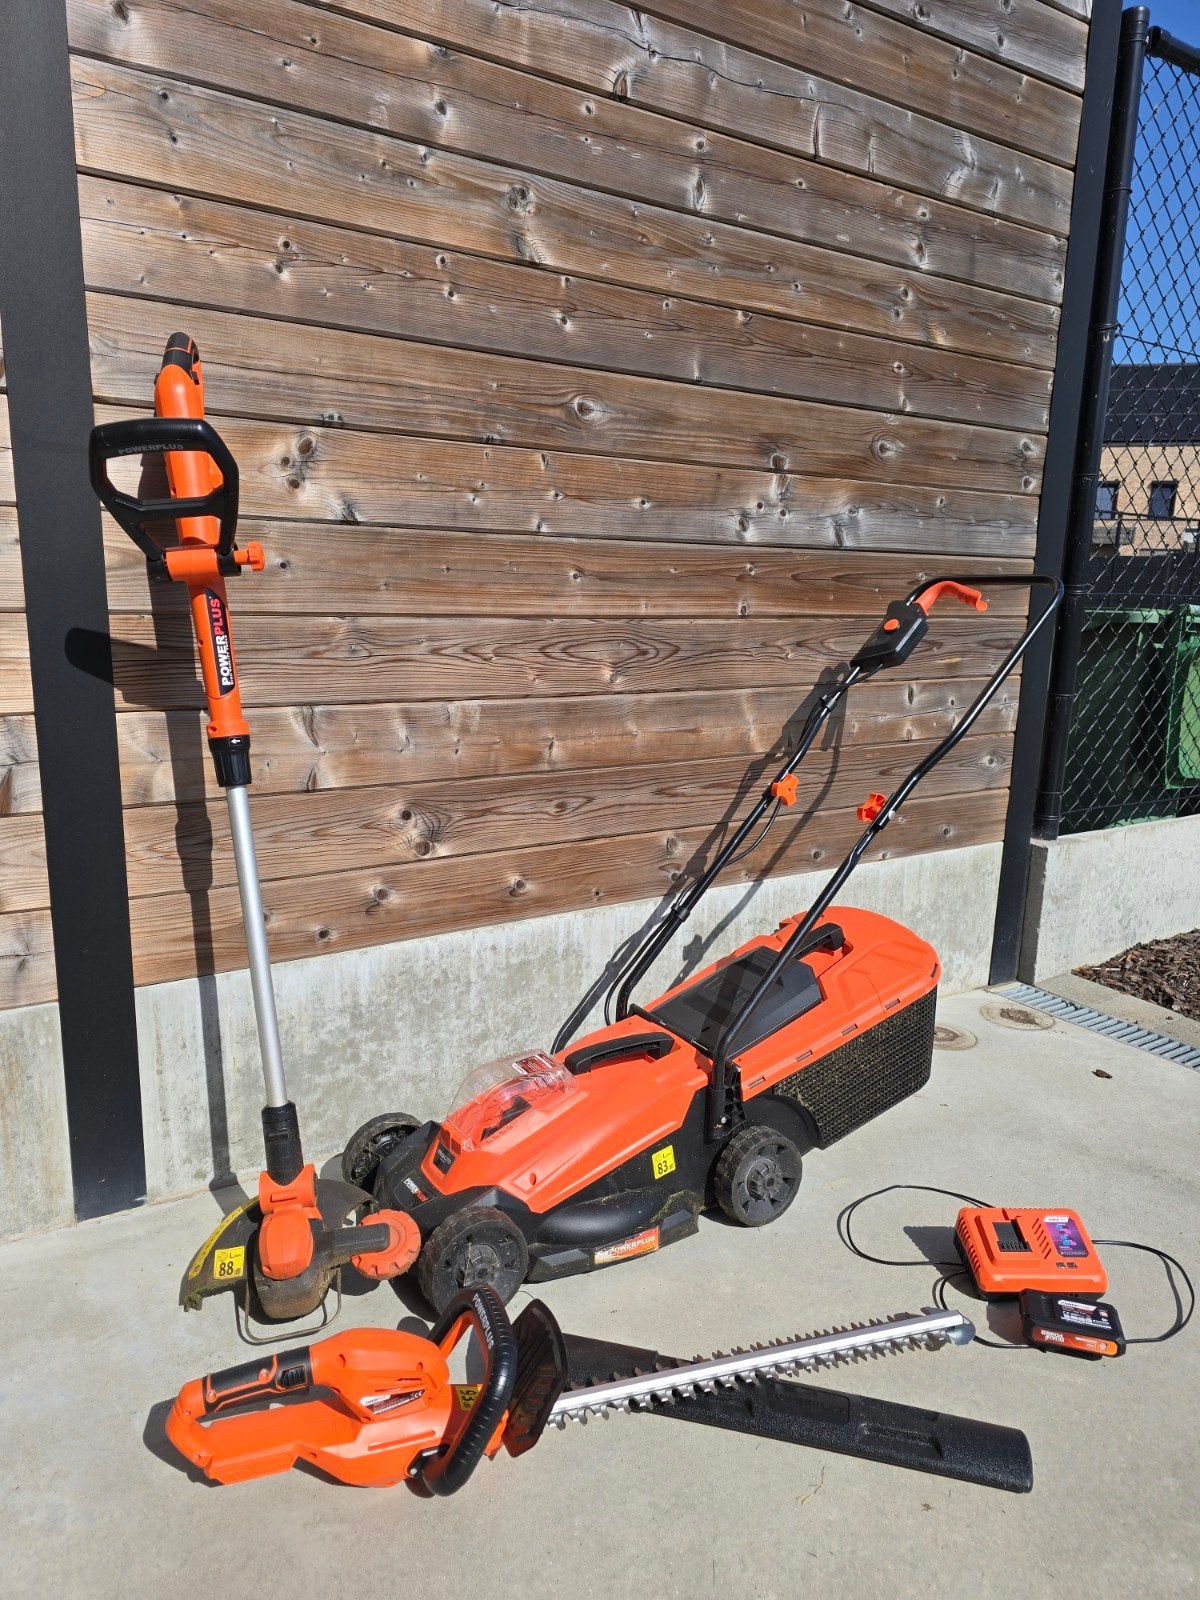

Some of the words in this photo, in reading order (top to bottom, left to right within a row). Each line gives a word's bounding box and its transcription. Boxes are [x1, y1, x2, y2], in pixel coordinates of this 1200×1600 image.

[118, 443, 184, 454] POWERPLUS
[210, 598, 232, 686] POWERPLUS
[657, 1160, 668, 1175] 83
[218, 1261, 234, 1277] 88
[472, 1293, 495, 1350] POWERPLUS
